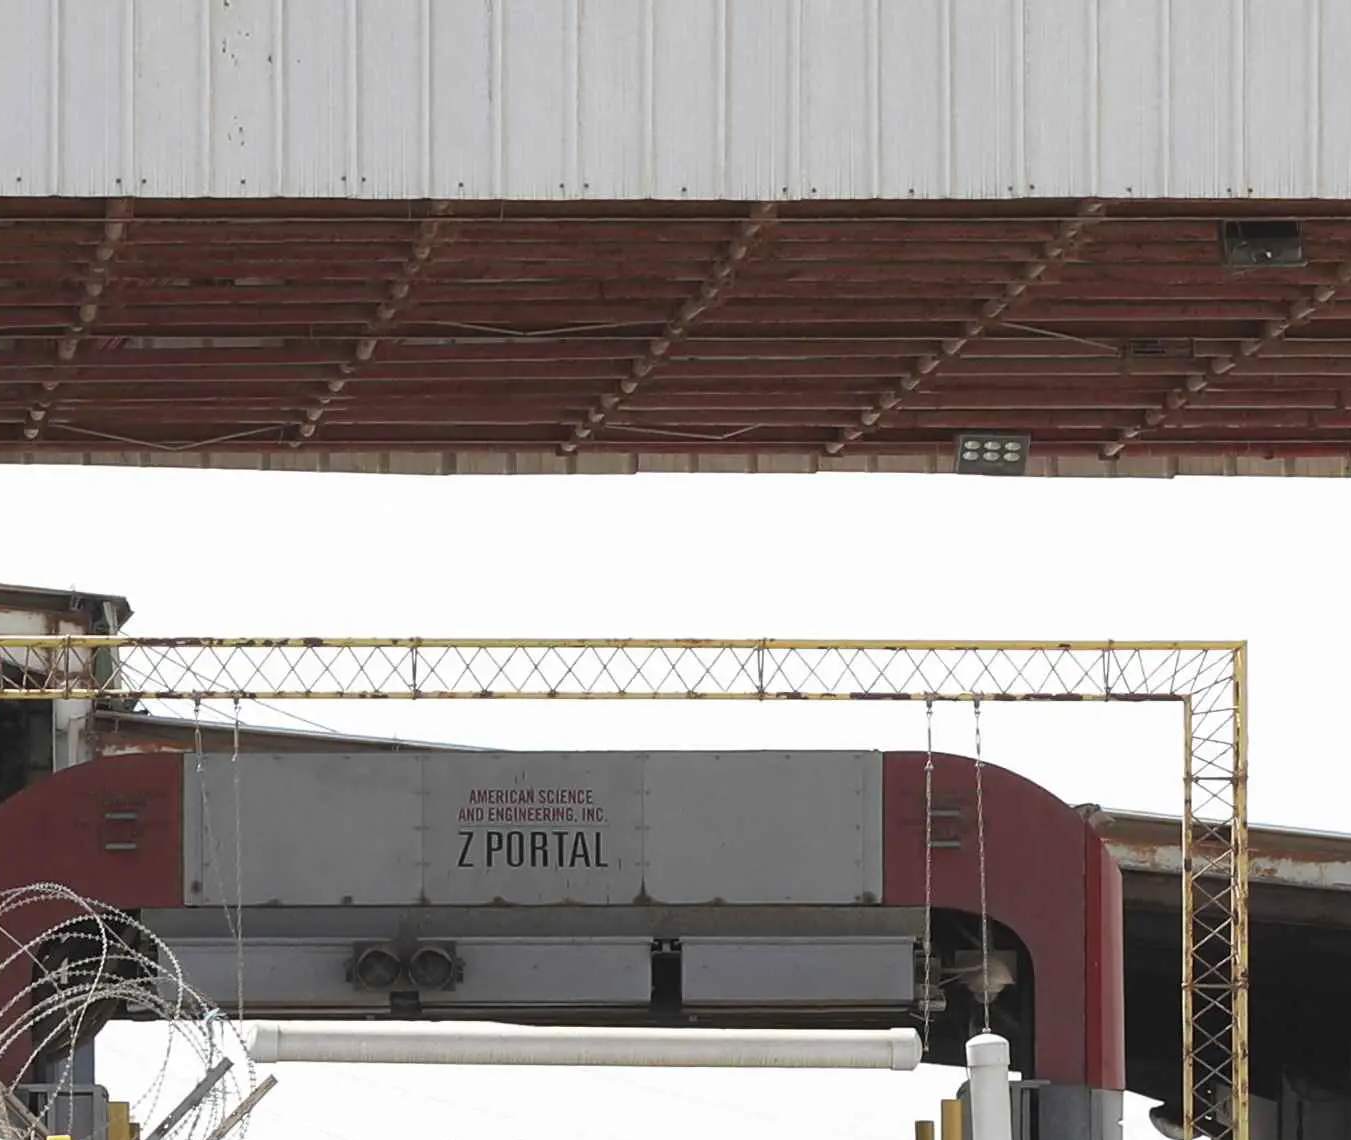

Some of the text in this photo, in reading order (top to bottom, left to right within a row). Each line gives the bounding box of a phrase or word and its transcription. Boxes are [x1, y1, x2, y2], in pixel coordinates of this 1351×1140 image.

[469, 789, 593, 804] AMERICAN SCIENCE
[458, 807, 608, 823] AND ENGINEERING, INC.
[458, 831, 608, 867] Z PORTAL
